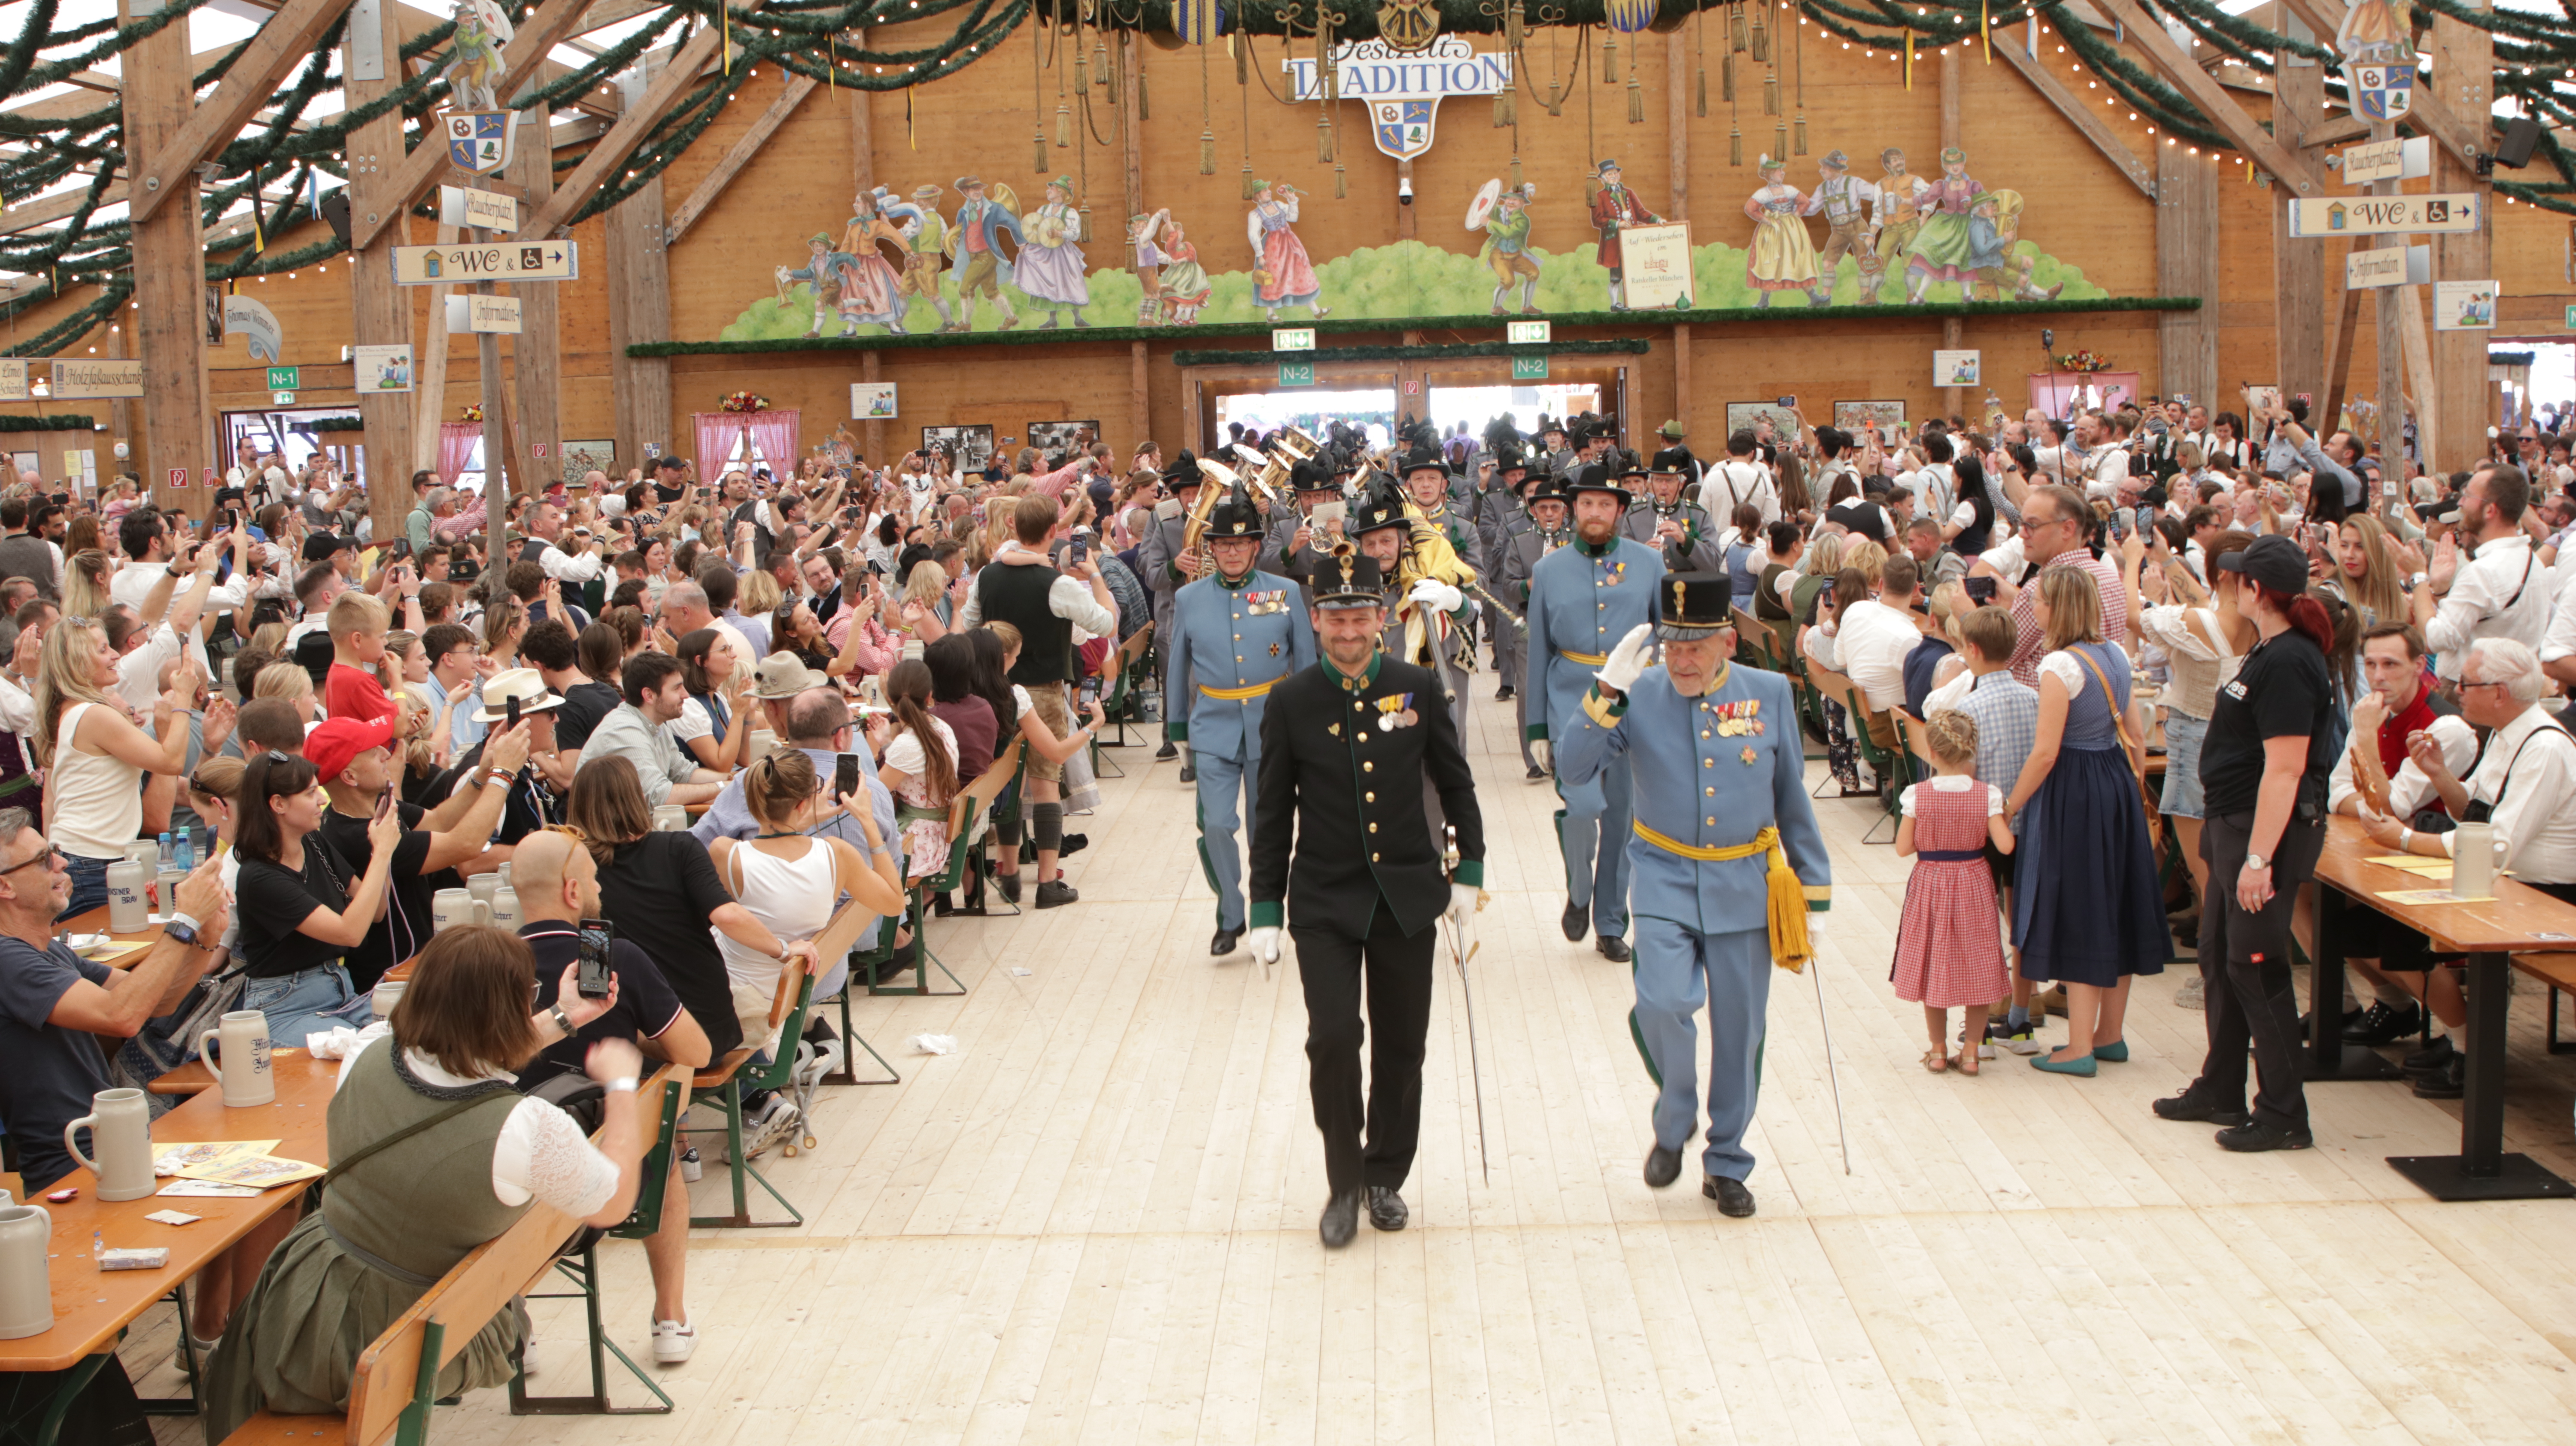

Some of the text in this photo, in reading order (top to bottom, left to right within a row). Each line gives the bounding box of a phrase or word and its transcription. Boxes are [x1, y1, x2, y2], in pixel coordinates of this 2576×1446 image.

[2353, 202, 2421, 225] WC &
[1624, 231, 1684, 247] Auf Wiedersehen
[450, 249, 516, 273] WC &
[2354, 254, 2398, 284] Information
[226, 307, 251, 323] Thomas
[477, 298, 515, 328] Information
[2, 364, 21, 378] Limo
[1284, 367, 1309, 380] N-2
[1518, 360, 1543, 373] N-2
[66, 366, 143, 391] Holzfaßausschank
[273, 372, 294, 385] N-1
